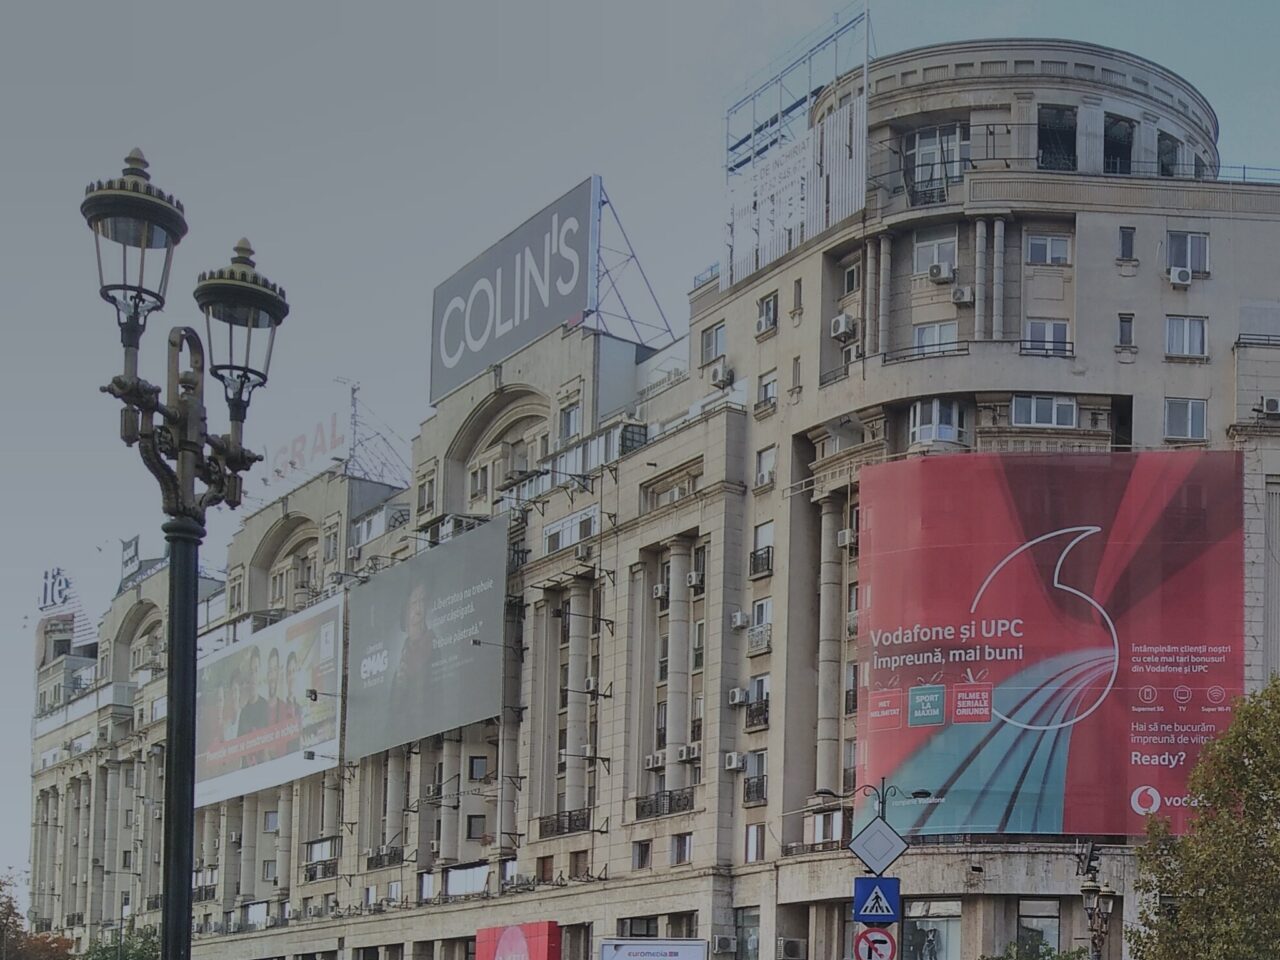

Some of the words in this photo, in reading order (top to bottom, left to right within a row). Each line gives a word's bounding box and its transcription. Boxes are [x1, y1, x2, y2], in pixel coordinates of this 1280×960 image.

[439, 212, 580, 369] COLIN'S
[870, 624, 955, 647] Vodafone
[960, 620, 976, 643] și
[981, 619, 1024, 637] UPC
[950, 645, 980, 662] mai
[985, 644, 1023, 660] buni
[1142, 655, 1159, 663] cele
[1160, 655, 1175, 663] mai
[1176, 655, 1190, 663] tari
[1191, 655, 1226, 663] bonusuri
[916, 694, 940, 703] SPORT
[957, 692, 980, 700] FILME
[921, 701, 932, 709] LA
[957, 699, 989, 707] SERIALE
[914, 708, 940, 717] MAXIM
[956, 707, 989, 715] ORIUNDE
[1131, 722, 1147, 731] Hai
[1148, 723, 1158, 732] să
[1160, 724, 1172, 732] ne
[1177, 734, 1189, 744] de
[1131, 751, 1186, 768] Ready?
